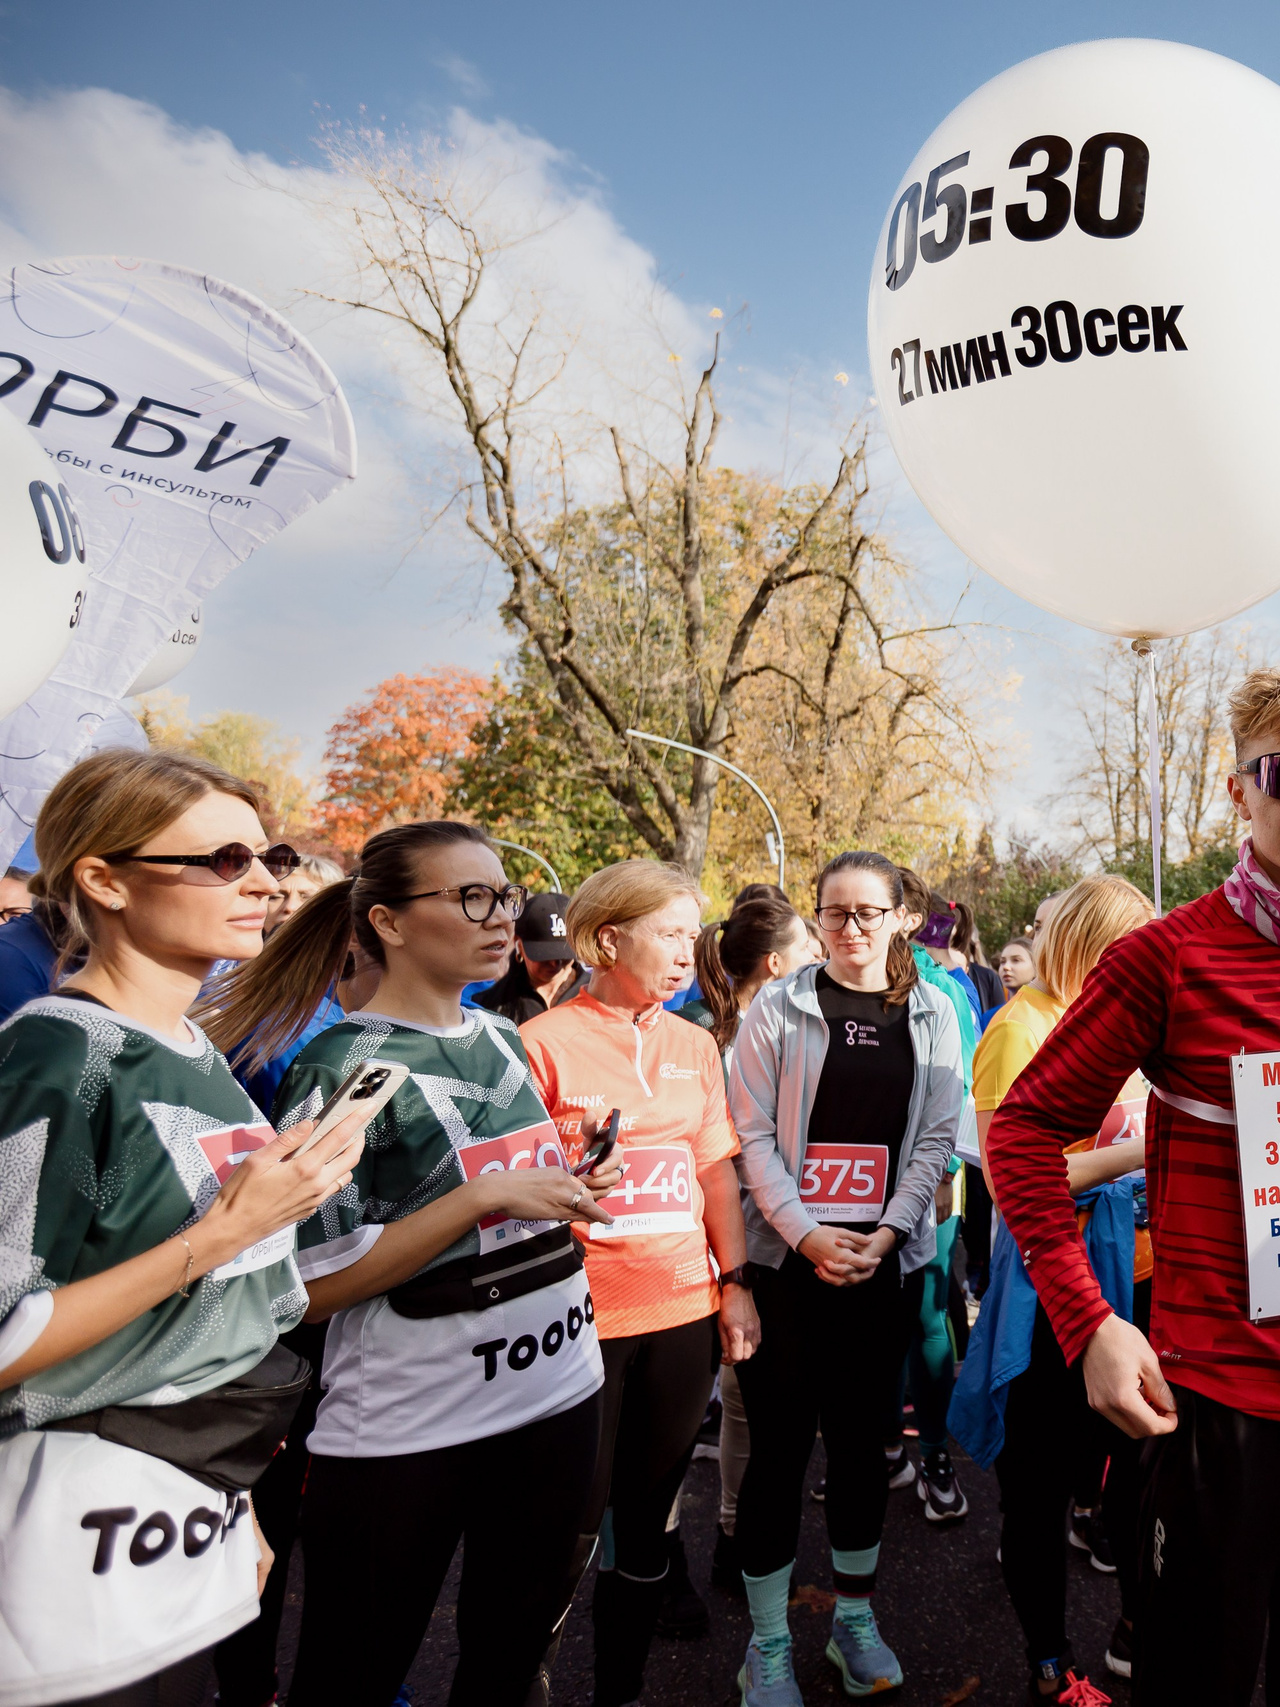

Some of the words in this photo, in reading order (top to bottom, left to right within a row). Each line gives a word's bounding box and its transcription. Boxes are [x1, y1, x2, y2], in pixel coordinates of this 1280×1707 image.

[886, 132, 1150, 291] 05:30
[120, 468, 253, 510] инсультом
[550, 914, 567, 937] LA
[560, 1094, 606, 1109] THINK
[606, 1160, 689, 1205] 446
[799, 1158, 875, 1197] 375
[1254, 1185, 1280, 1207] на
